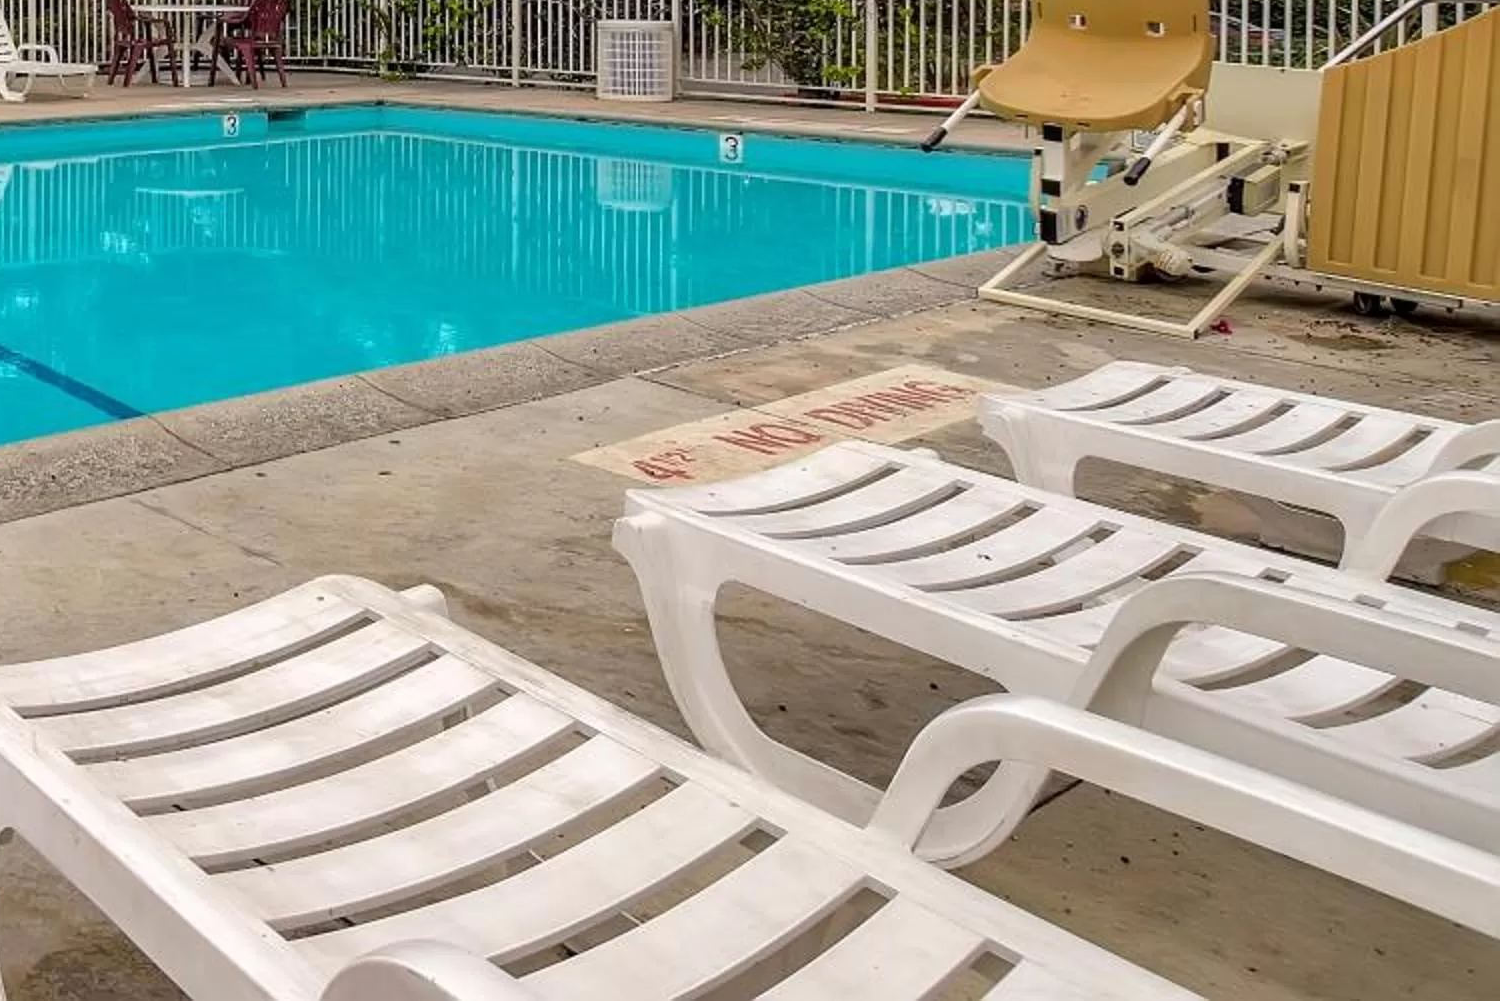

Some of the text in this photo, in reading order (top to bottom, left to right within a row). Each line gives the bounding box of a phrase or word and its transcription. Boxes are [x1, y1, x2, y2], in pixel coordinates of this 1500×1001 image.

[227, 116, 237, 135] 3
[725, 136, 739, 160] 3
[712, 424, 822, 456] NO
[803, 380, 978, 430] DIVING
